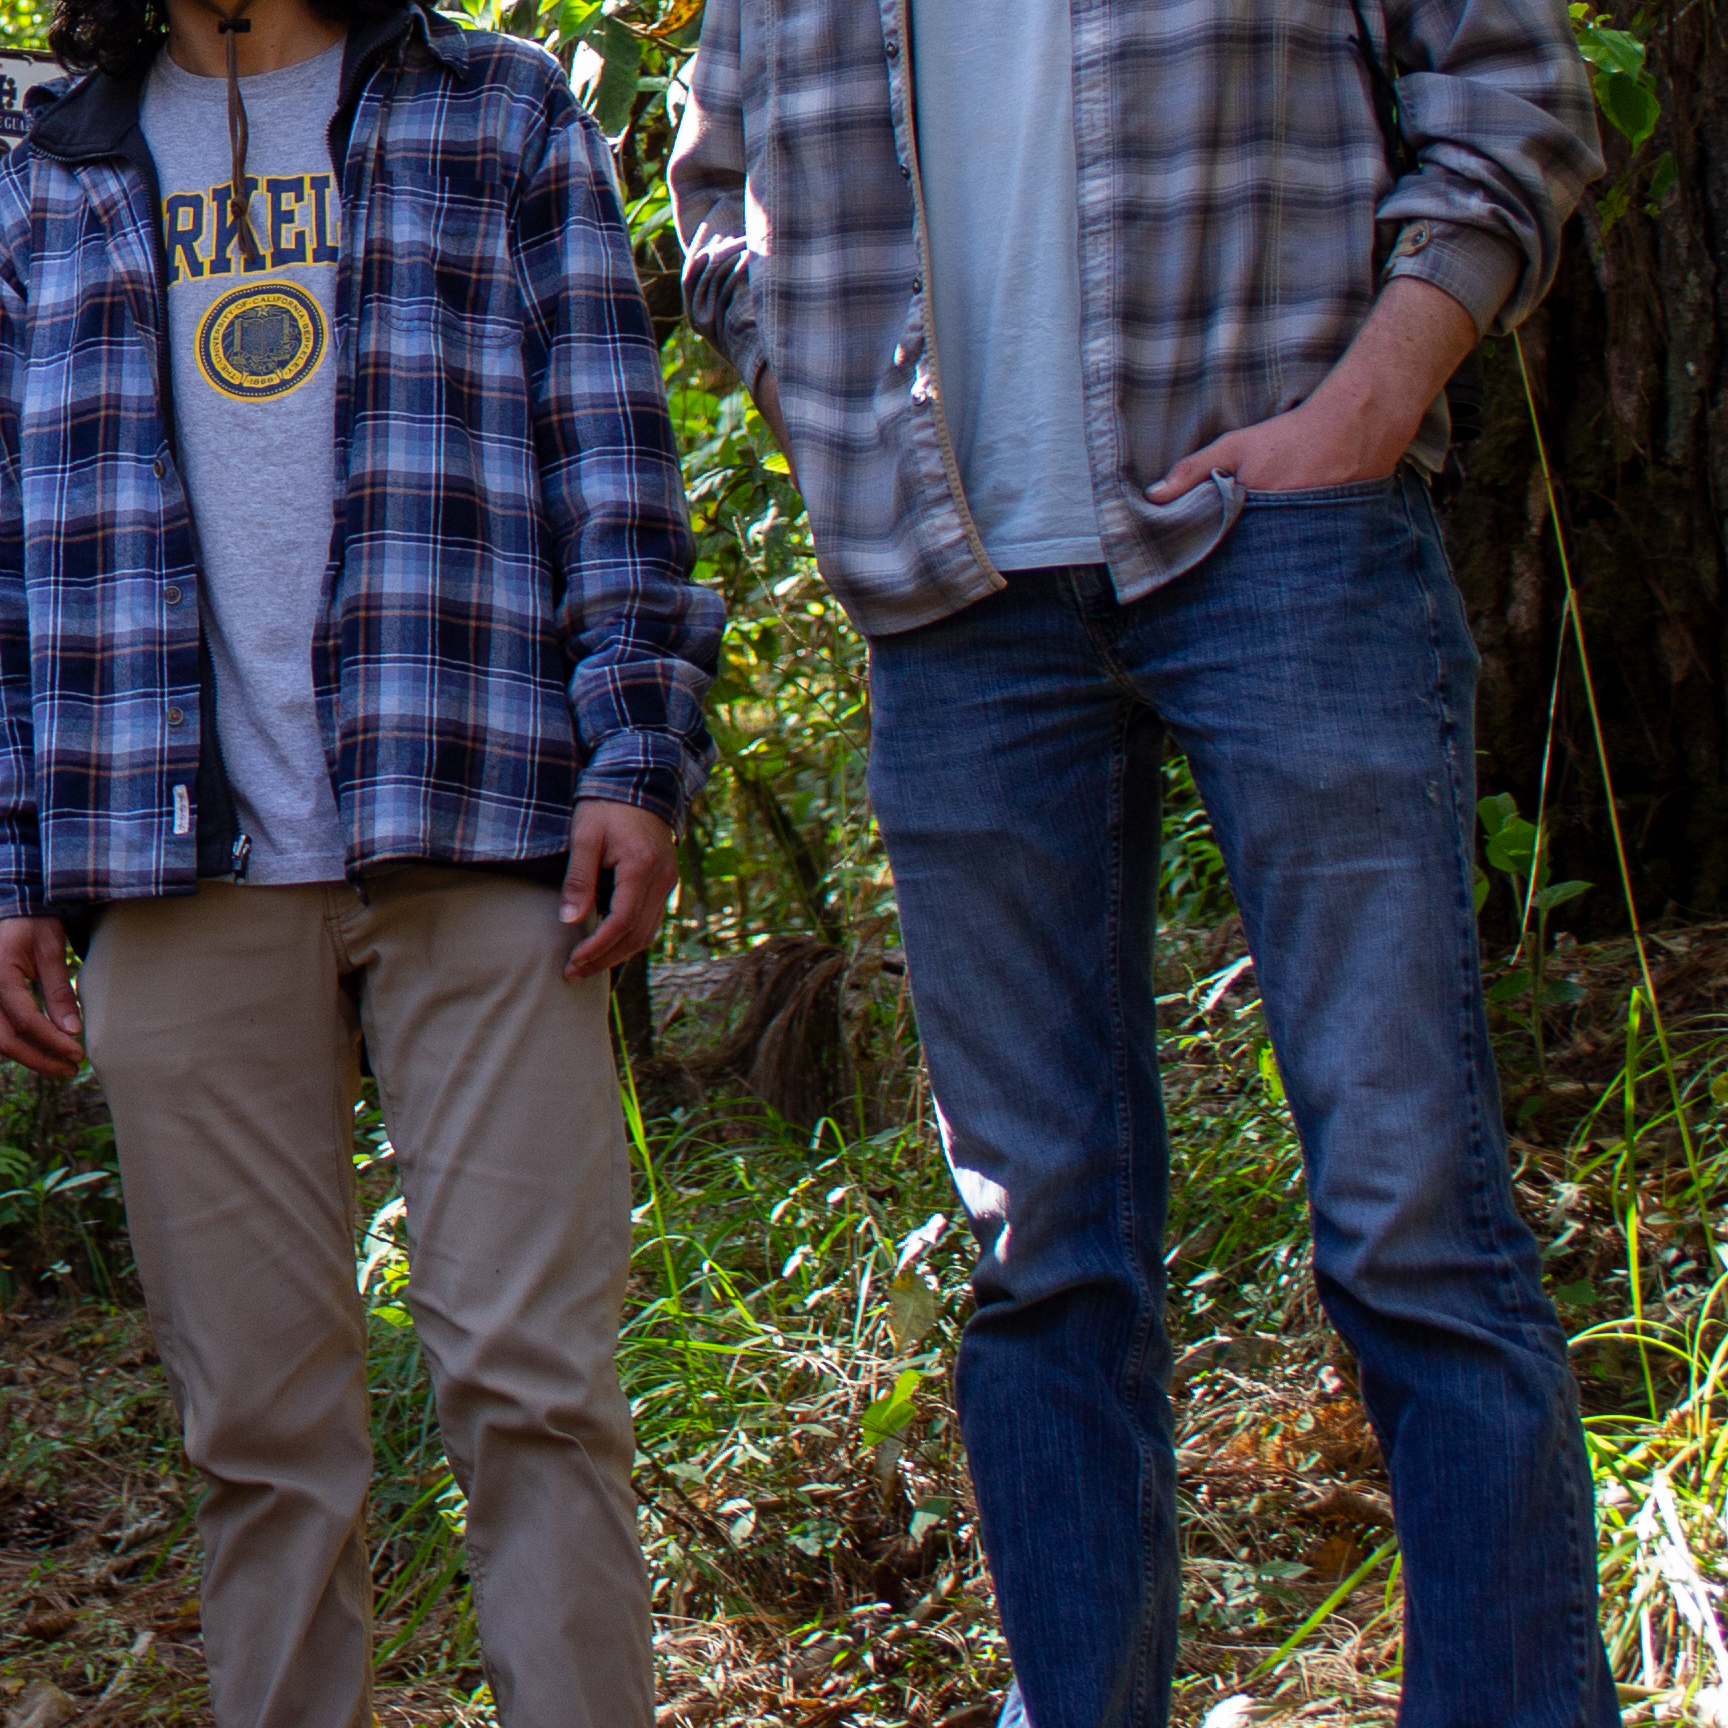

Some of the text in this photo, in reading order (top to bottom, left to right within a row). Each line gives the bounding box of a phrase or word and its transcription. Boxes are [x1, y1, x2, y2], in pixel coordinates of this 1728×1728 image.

[213, 296, 312, 380] THE UNIVERSITY OF CALIFORNIA BERKELEY
